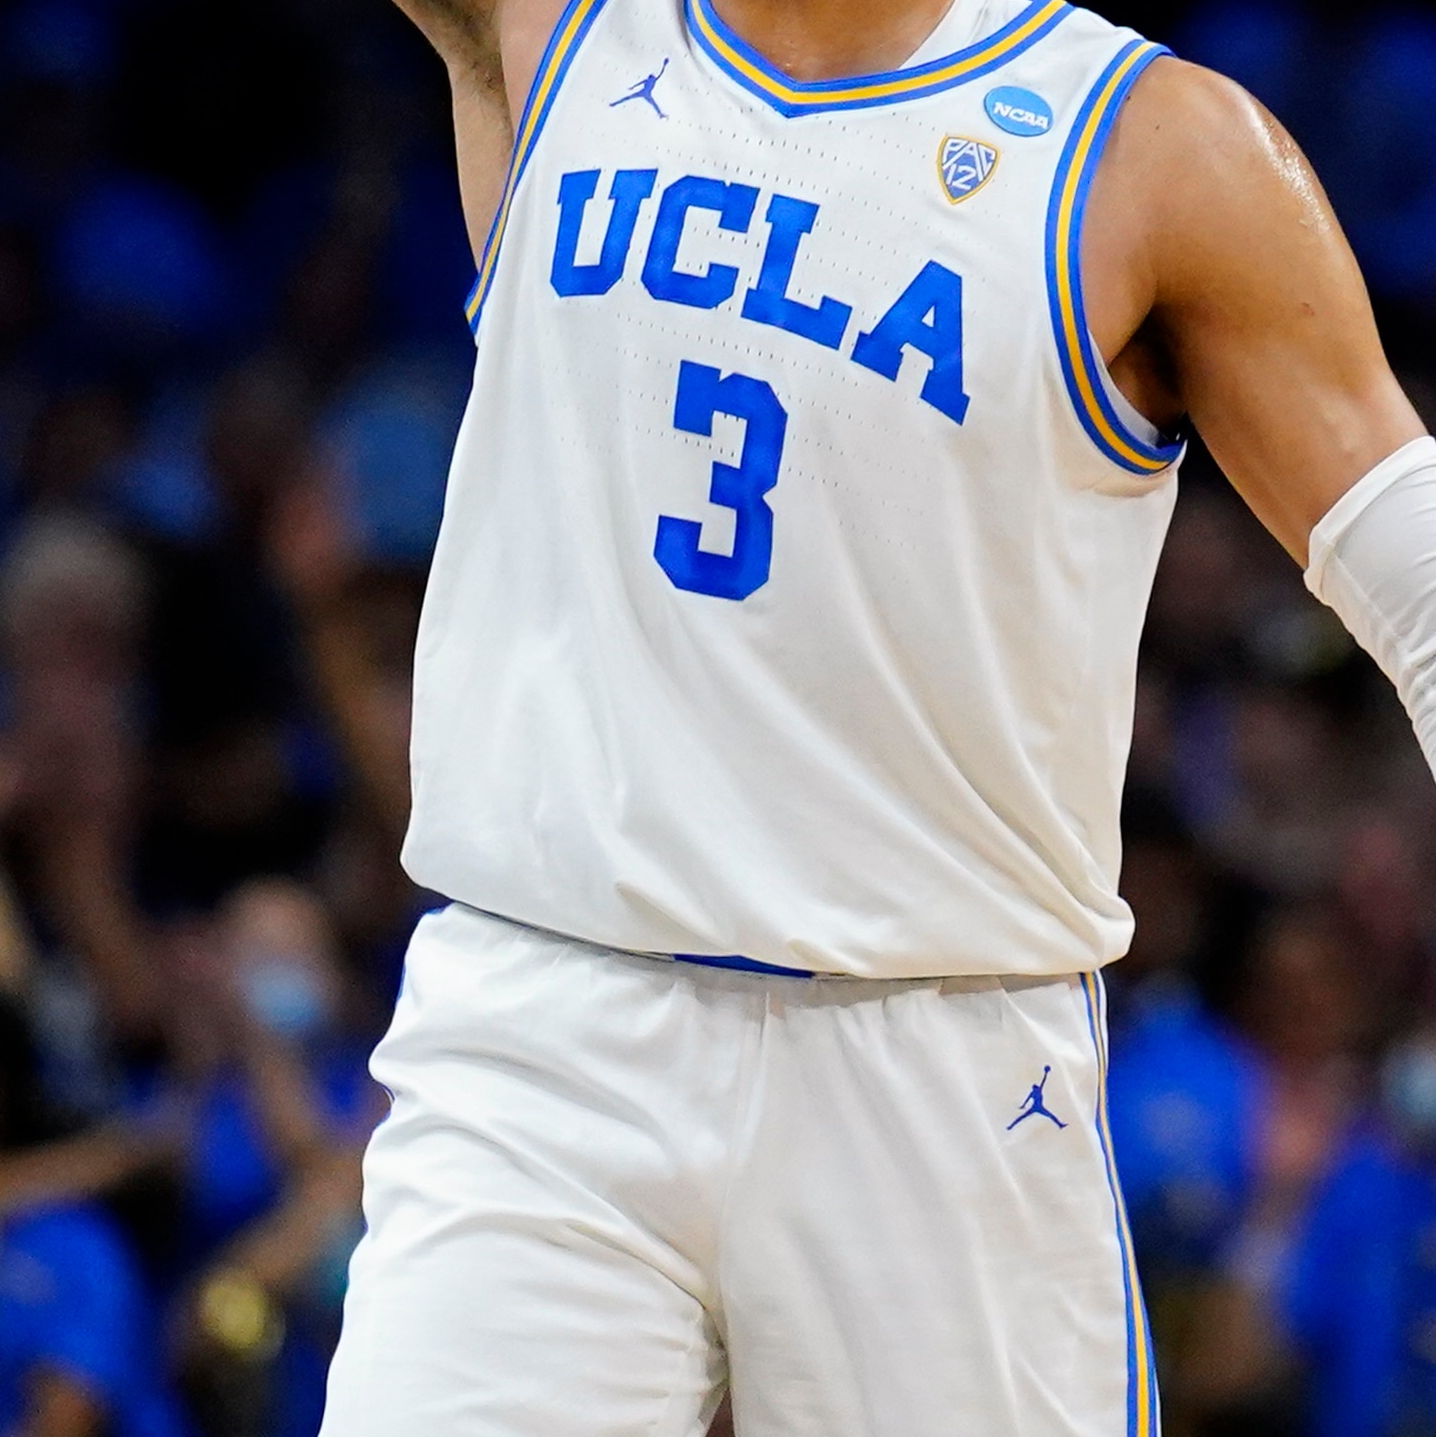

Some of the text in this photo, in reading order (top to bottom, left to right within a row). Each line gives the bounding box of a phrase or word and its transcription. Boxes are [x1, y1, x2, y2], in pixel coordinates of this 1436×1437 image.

[993, 102, 1049, 130] NCAA
[942, 137, 997, 182] PAC
[945, 163, 977, 191] 12
[550, 168, 970, 425] UCLA
[654, 360, 788, 601] 3
